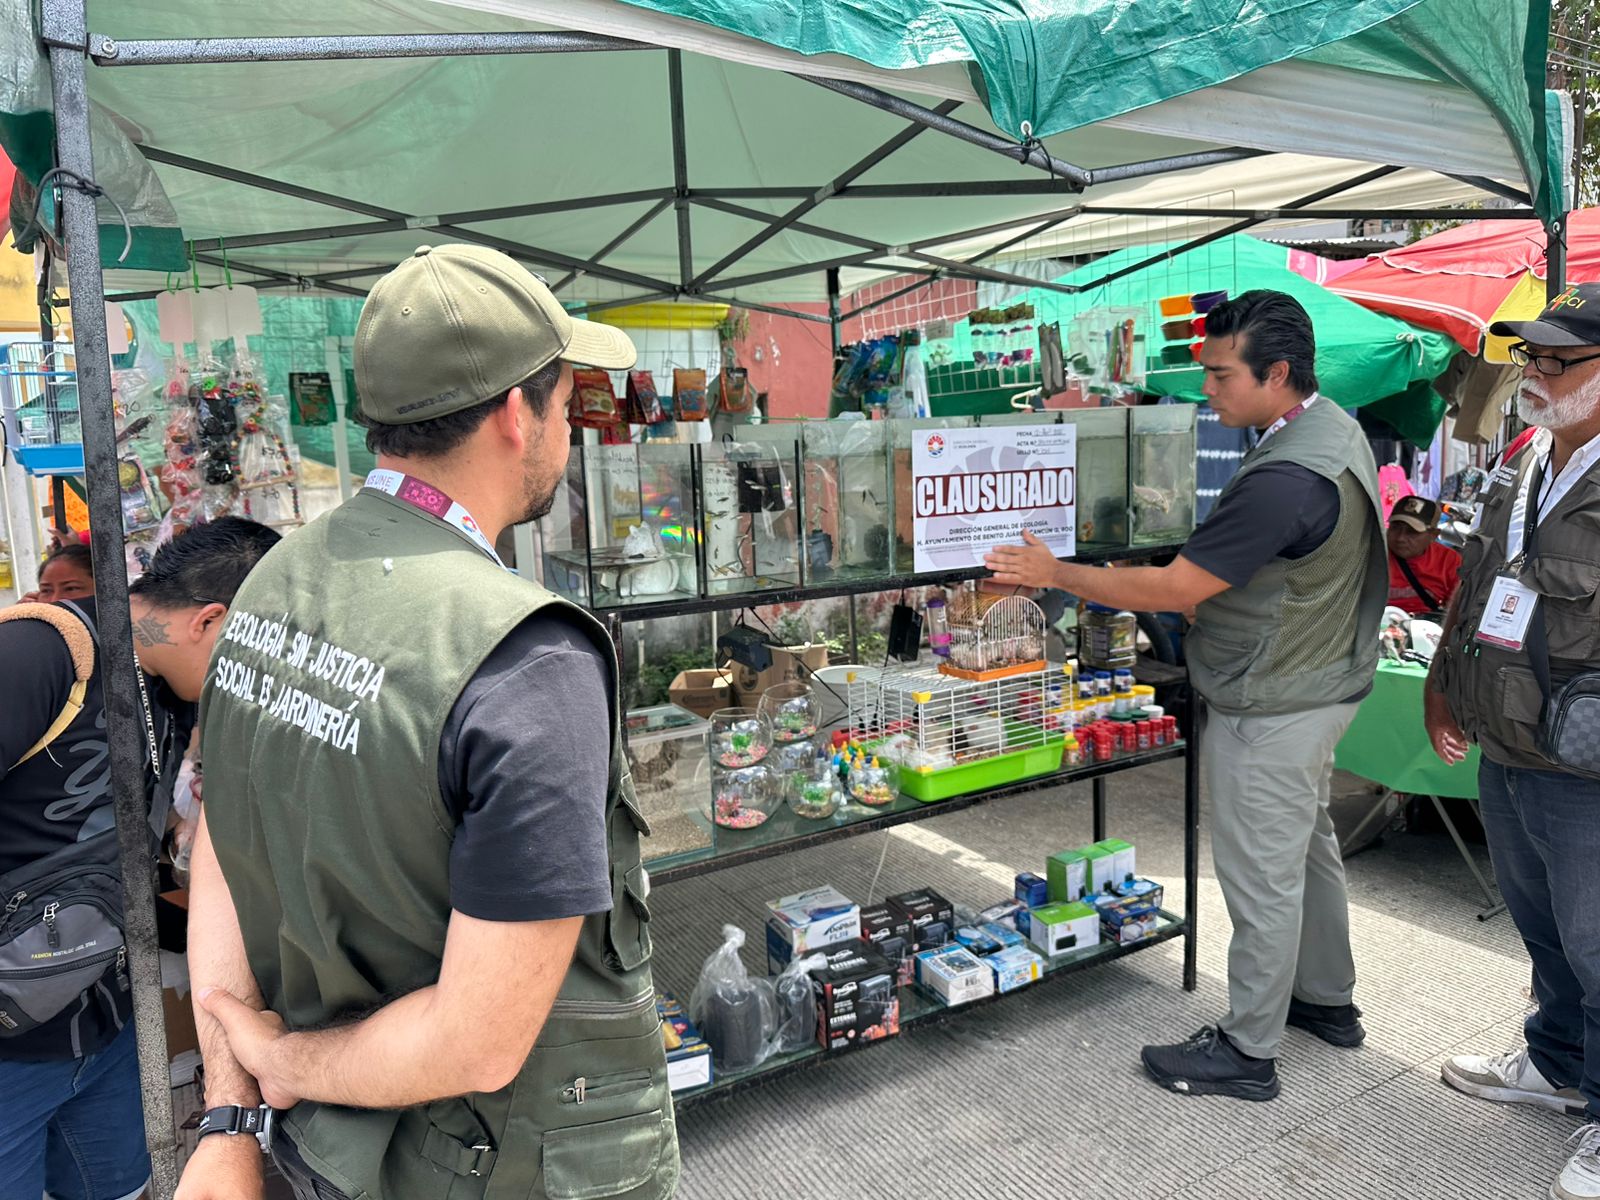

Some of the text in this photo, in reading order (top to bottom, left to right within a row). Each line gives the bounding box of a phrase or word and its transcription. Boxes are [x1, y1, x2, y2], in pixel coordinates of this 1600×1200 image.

[916, 468, 1074, 517] CLAUSURADO
[924, 535, 972, 545] AYUNTAMIENTO
[982, 532, 1004, 540] BENITO
[949, 525, 982, 535] DIRECCIÓN
[983, 523, 1011, 531] GENERAL
[1020, 519, 1048, 528] ECOLOGÍA
[225, 610, 386, 702] ECOLOGÍA SIN JUSTICIA
[215, 656, 361, 755] SOCIAL ES JARDINERÍA
[31, 952, 52, 960] FASHION
